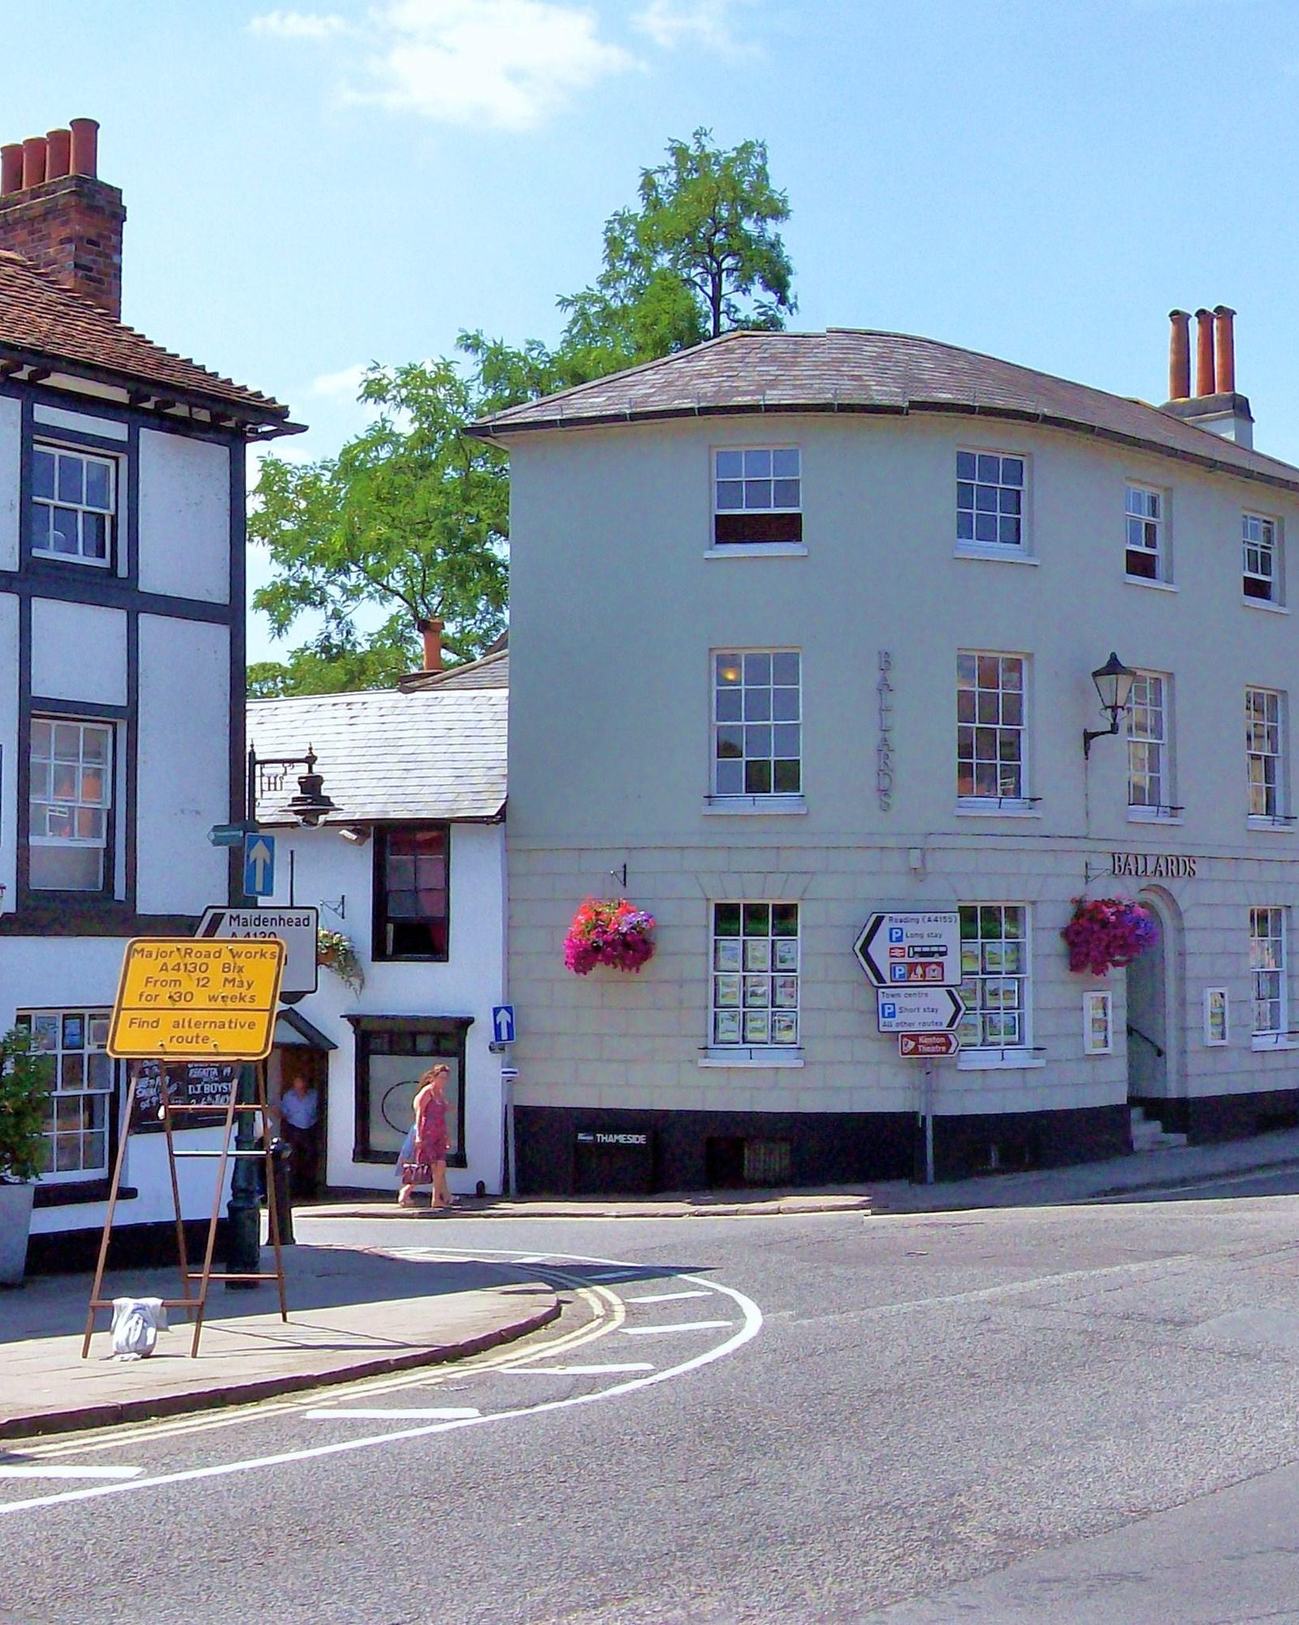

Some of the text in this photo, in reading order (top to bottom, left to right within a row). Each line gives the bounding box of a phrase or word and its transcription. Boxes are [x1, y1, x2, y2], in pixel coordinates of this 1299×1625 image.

[1112, 853, 1196, 877] BALLARDS
[229, 914, 311, 927] Maidenhead
[888, 916, 920, 925] Reading
[905, 932, 925, 940] Long
[926, 932, 942, 940] stay
[132, 948, 277, 961] Major Road works
[159, 962, 245, 974] A4130 Bix
[144, 976, 254, 990] From 12 May
[138, 991, 257, 1004] for 30 weeks
[881, 991, 900, 999] Town
[898, 1006, 921, 1014] Short
[923, 1007, 939, 1015] stay
[128, 1017, 257, 1030] Find alternative
[895, 1020, 916, 1028] other
[169, 1033, 211, 1045] route
[596, 1133, 647, 1144] THAMESIDE
